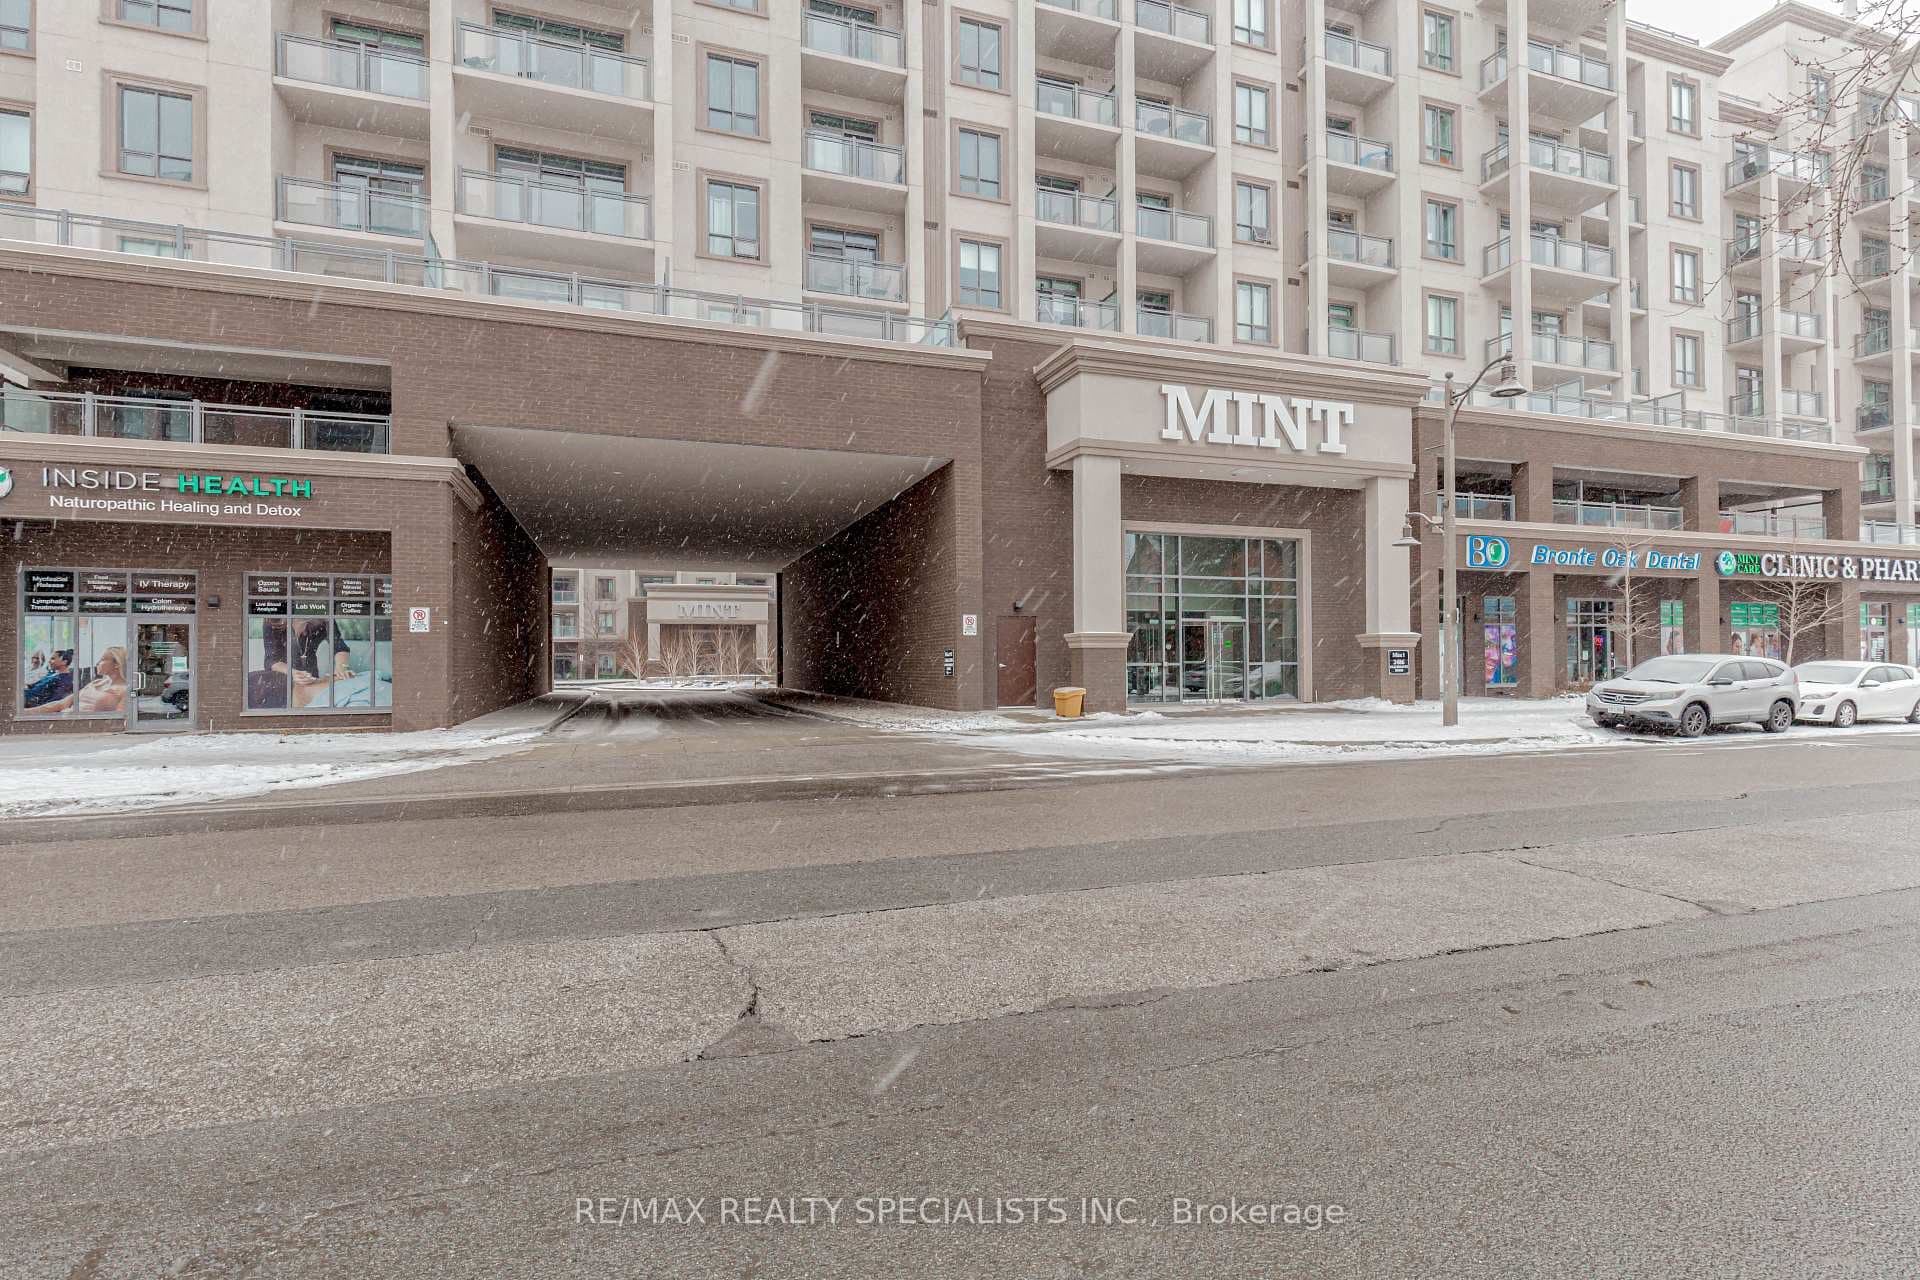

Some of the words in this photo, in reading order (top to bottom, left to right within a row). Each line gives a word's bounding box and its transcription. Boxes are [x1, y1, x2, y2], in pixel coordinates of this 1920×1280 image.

[1161, 384, 1354, 454] MINT
[43, 467, 161, 491] INSIDE
[178, 473, 312, 498] HEALTH
[50, 495, 156, 511] Naturopathic
[161, 500, 219, 516] Healing
[224, 503, 251, 514] and
[257, 504, 301, 516] Detox
[1530, 544, 1597, 567] Bronte
[1602, 547, 1639, 568] Oak
[1645, 550, 1701, 569] Dental
[1737, 553, 1760, 564] MINT
[1761, 553, 1838, 578] CLINIC
[1842, 556, 1857, 579] &
[1861, 558, 1920, 581] PHAR
[1737, 564, 1760, 574] CARE
[140, 580, 149, 588] IV
[152, 580, 189, 589] Therapy
